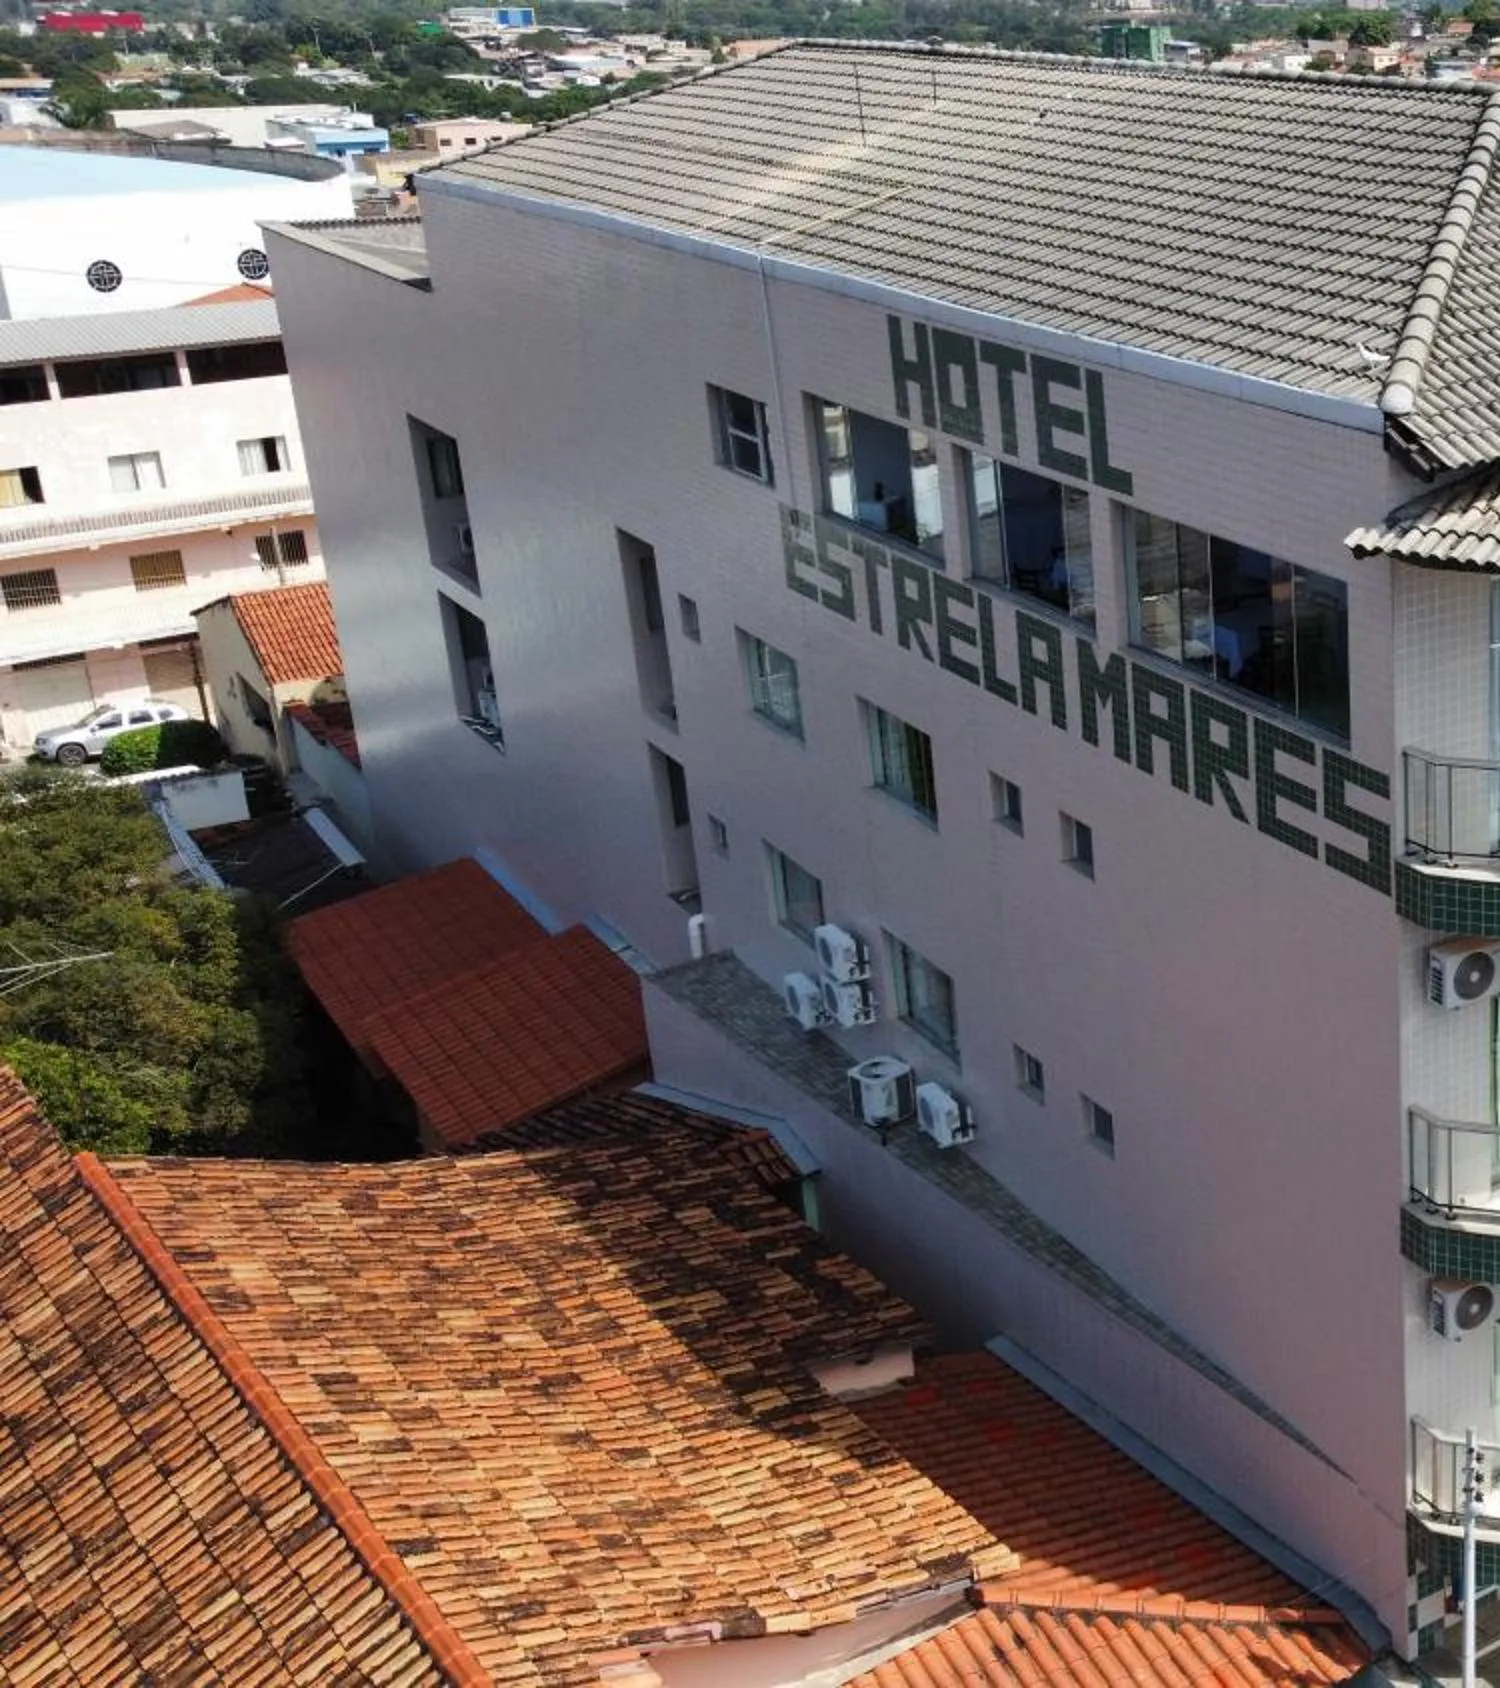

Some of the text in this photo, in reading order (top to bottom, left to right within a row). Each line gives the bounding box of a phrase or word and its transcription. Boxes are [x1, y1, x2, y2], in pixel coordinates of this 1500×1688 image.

[887, 314, 1133, 496] HOTEL
[779, 504, 1392, 897] ESTRELA MARES
